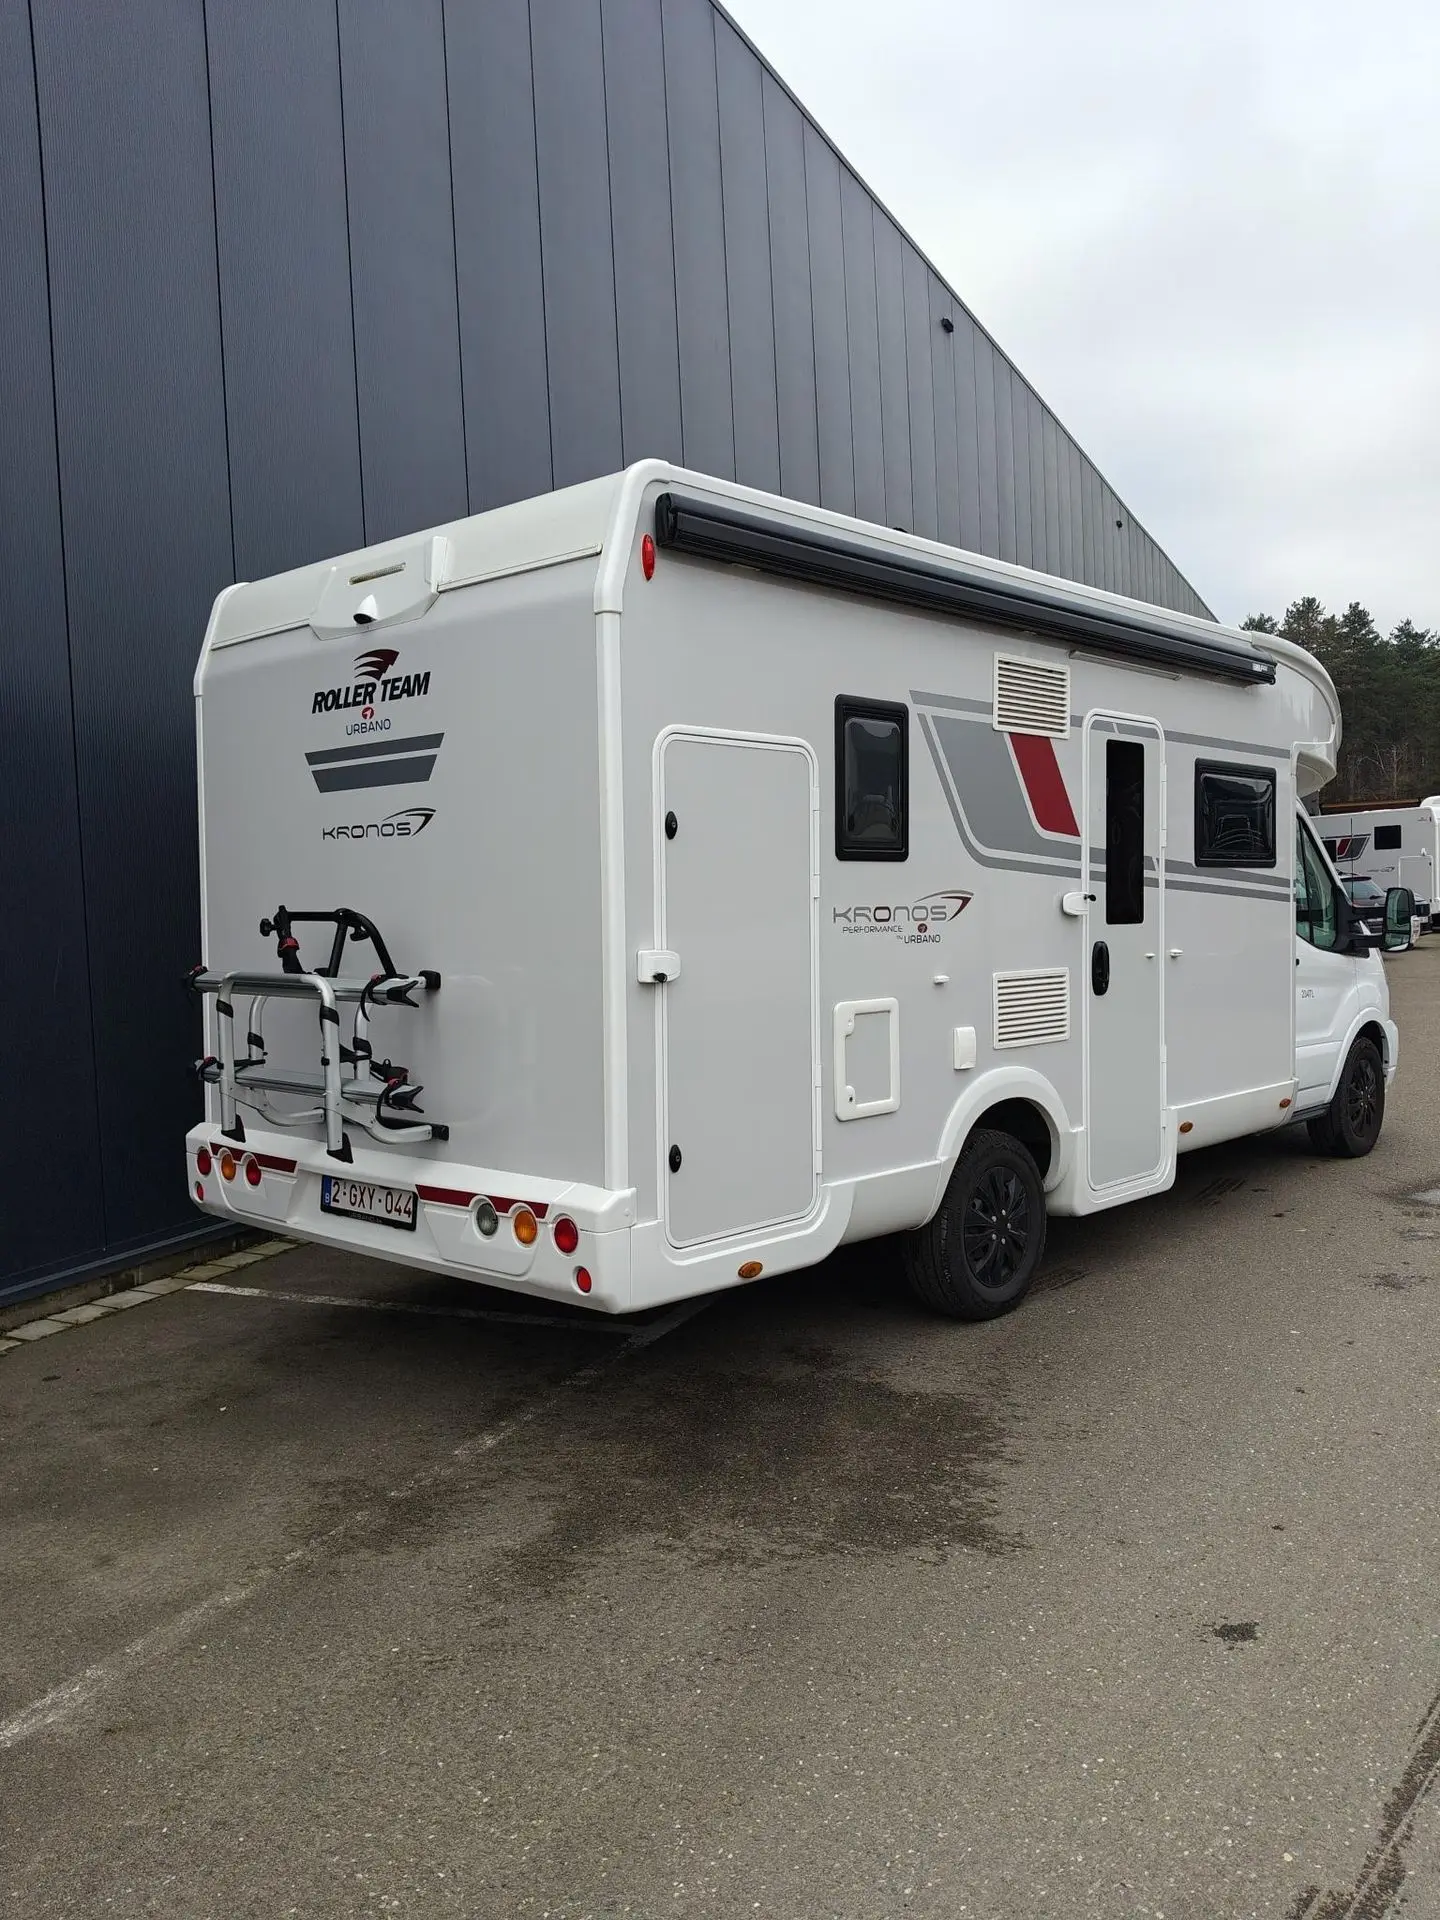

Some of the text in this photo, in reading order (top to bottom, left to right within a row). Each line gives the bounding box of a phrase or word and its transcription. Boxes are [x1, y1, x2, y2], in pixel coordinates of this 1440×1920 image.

[312, 671, 431, 714] ROLLER TEAM
[345, 718, 391, 735] URBANO
[323, 822, 411, 840] KRONOS
[832, 905, 948, 923] KRONOS
[842, 925, 903, 934] PERFORMANCE
[904, 934, 941, 944] URBANO
